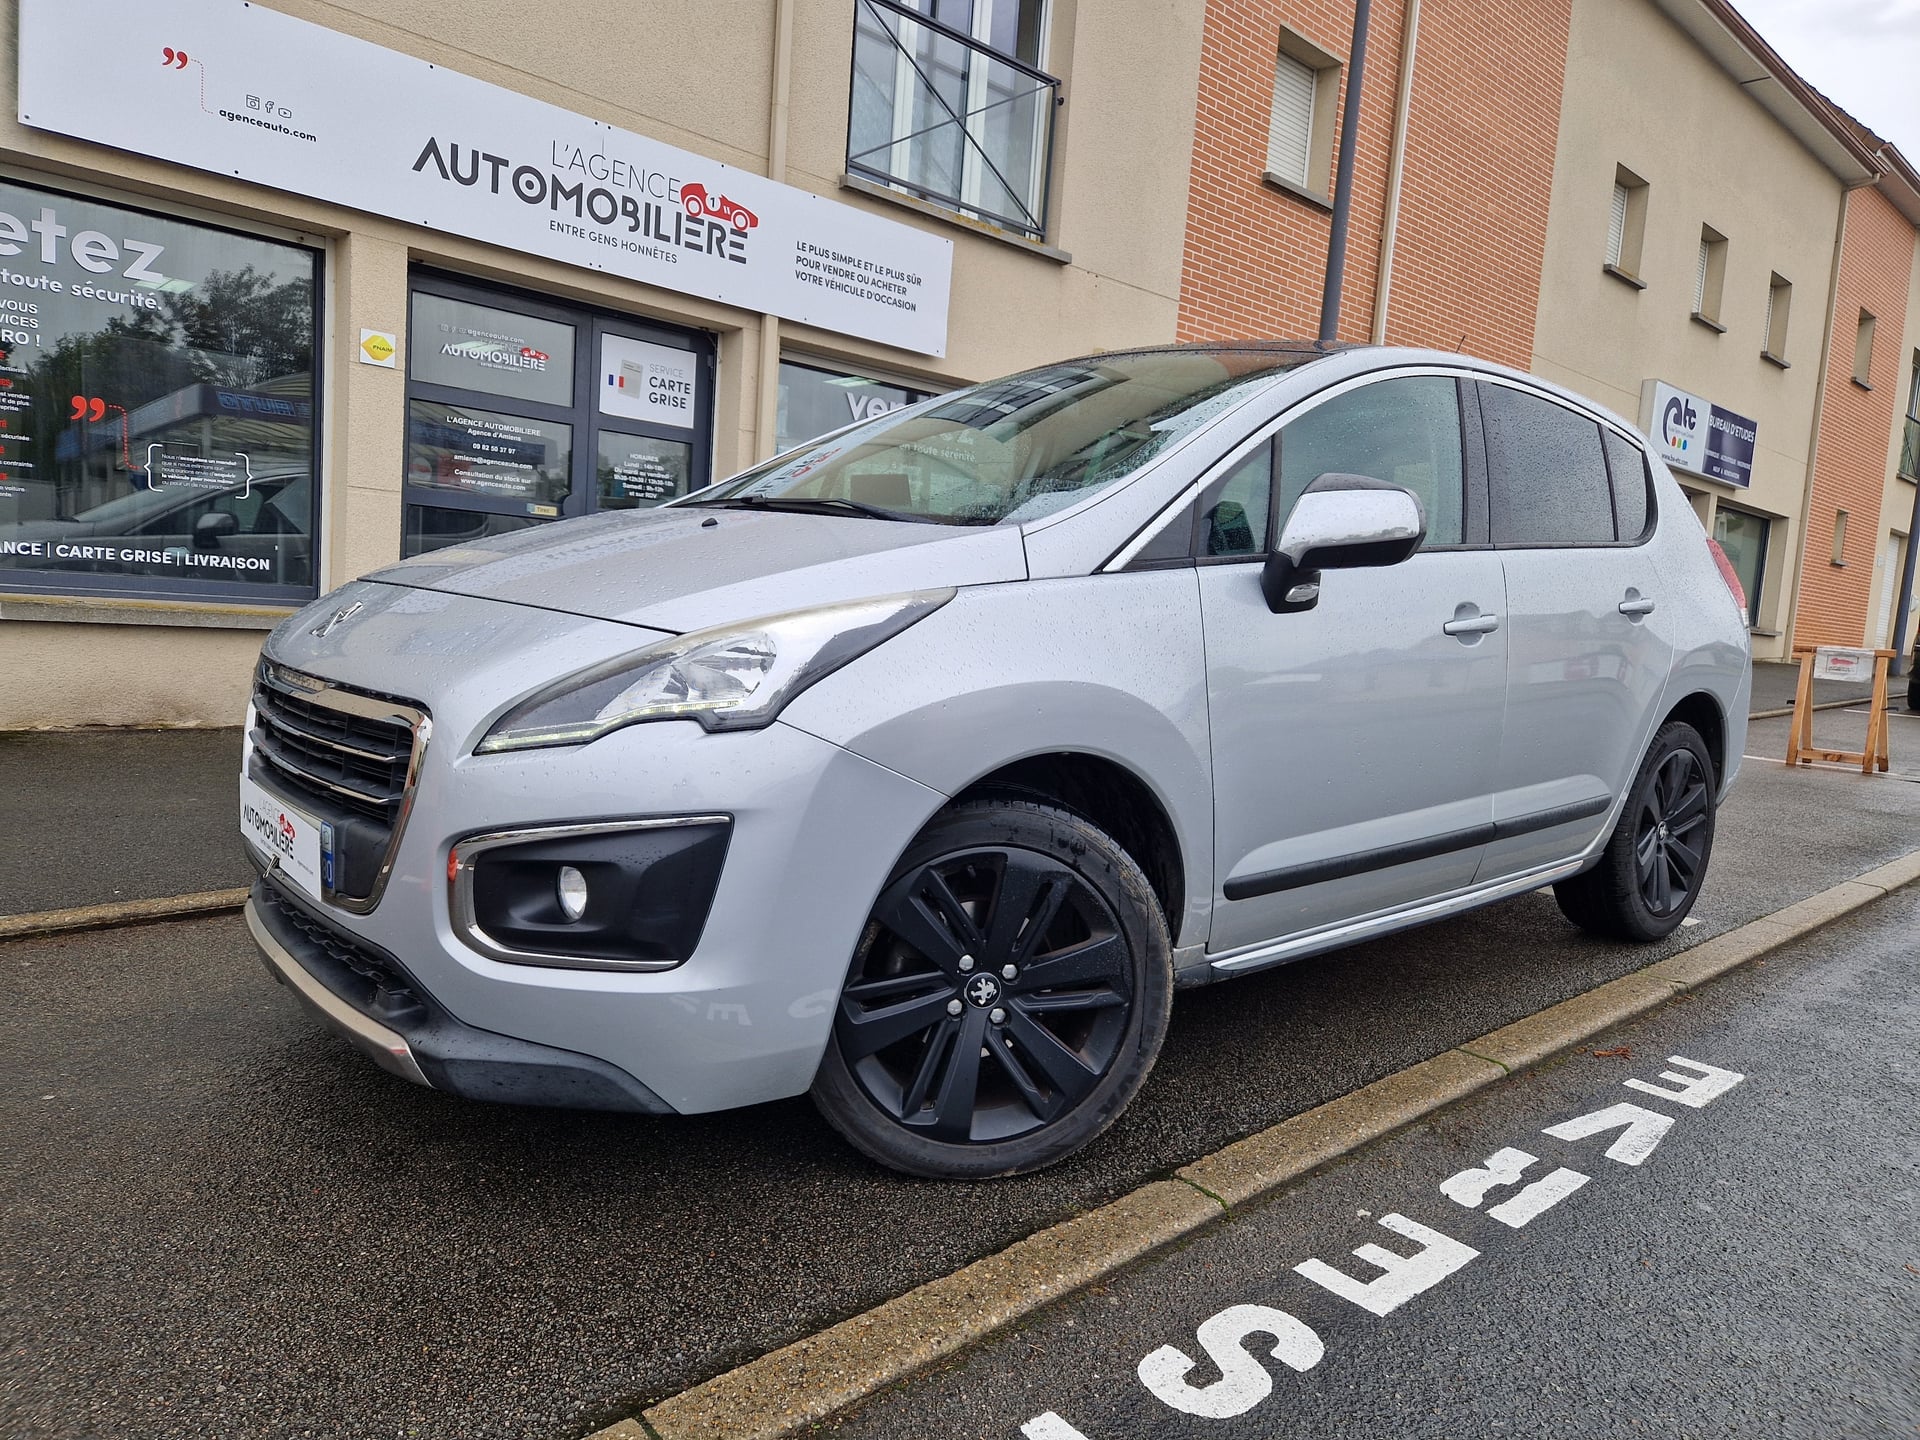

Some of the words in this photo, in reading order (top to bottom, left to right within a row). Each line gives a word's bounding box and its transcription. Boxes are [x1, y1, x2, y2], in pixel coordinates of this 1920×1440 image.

[219, 107, 317, 143] agenceauto.com
[551, 139, 682, 204] L'AGENCE
[549, 219, 587, 239] ENTRE
[588, 231, 618, 248] GENS
[621, 241, 678, 265] HONNÊTES
[796, 240, 807, 252] LE
[808, 244, 830, 259] PLUS
[831, 251, 863, 269] SIMPLE
[863, 261, 874, 272] ET
[874, 264, 885, 275] LE
[885, 268, 905, 282] PLUS
[906, 273, 922, 287] SÛR
[795, 255, 821, 271] POUR
[822, 263, 856, 281] VENDRE
[856, 274, 870, 285] OU
[870, 277, 907, 296] ACHETER
[71, 280, 162, 311] sécurité.
[795, 269, 824, 286] VOTRE
[824, 277, 865, 298] VÉHICULE
[866, 290, 917, 312] D'OCCASION
[467, 328, 525, 344] agenceauto.com
[649, 363, 684, 379] SERVICE
[649, 376, 691, 394] CARTE
[648, 392, 687, 409] GRISE
[446, 416, 483, 428] L'AGENCE
[484, 422, 541, 437] AUTOMOBILIERE
[467, 428, 492, 438] Agence
[493, 431, 522, 442] d'Amiens
[1709, 415, 1731, 434] BUREAU
[913, 443, 938, 456] toute
[454, 469, 493, 480] Consultation
[55, 544, 116, 560] CARTE
[120, 548, 172, 564] GRISE
[185, 553, 270, 571] LIVRAISON
